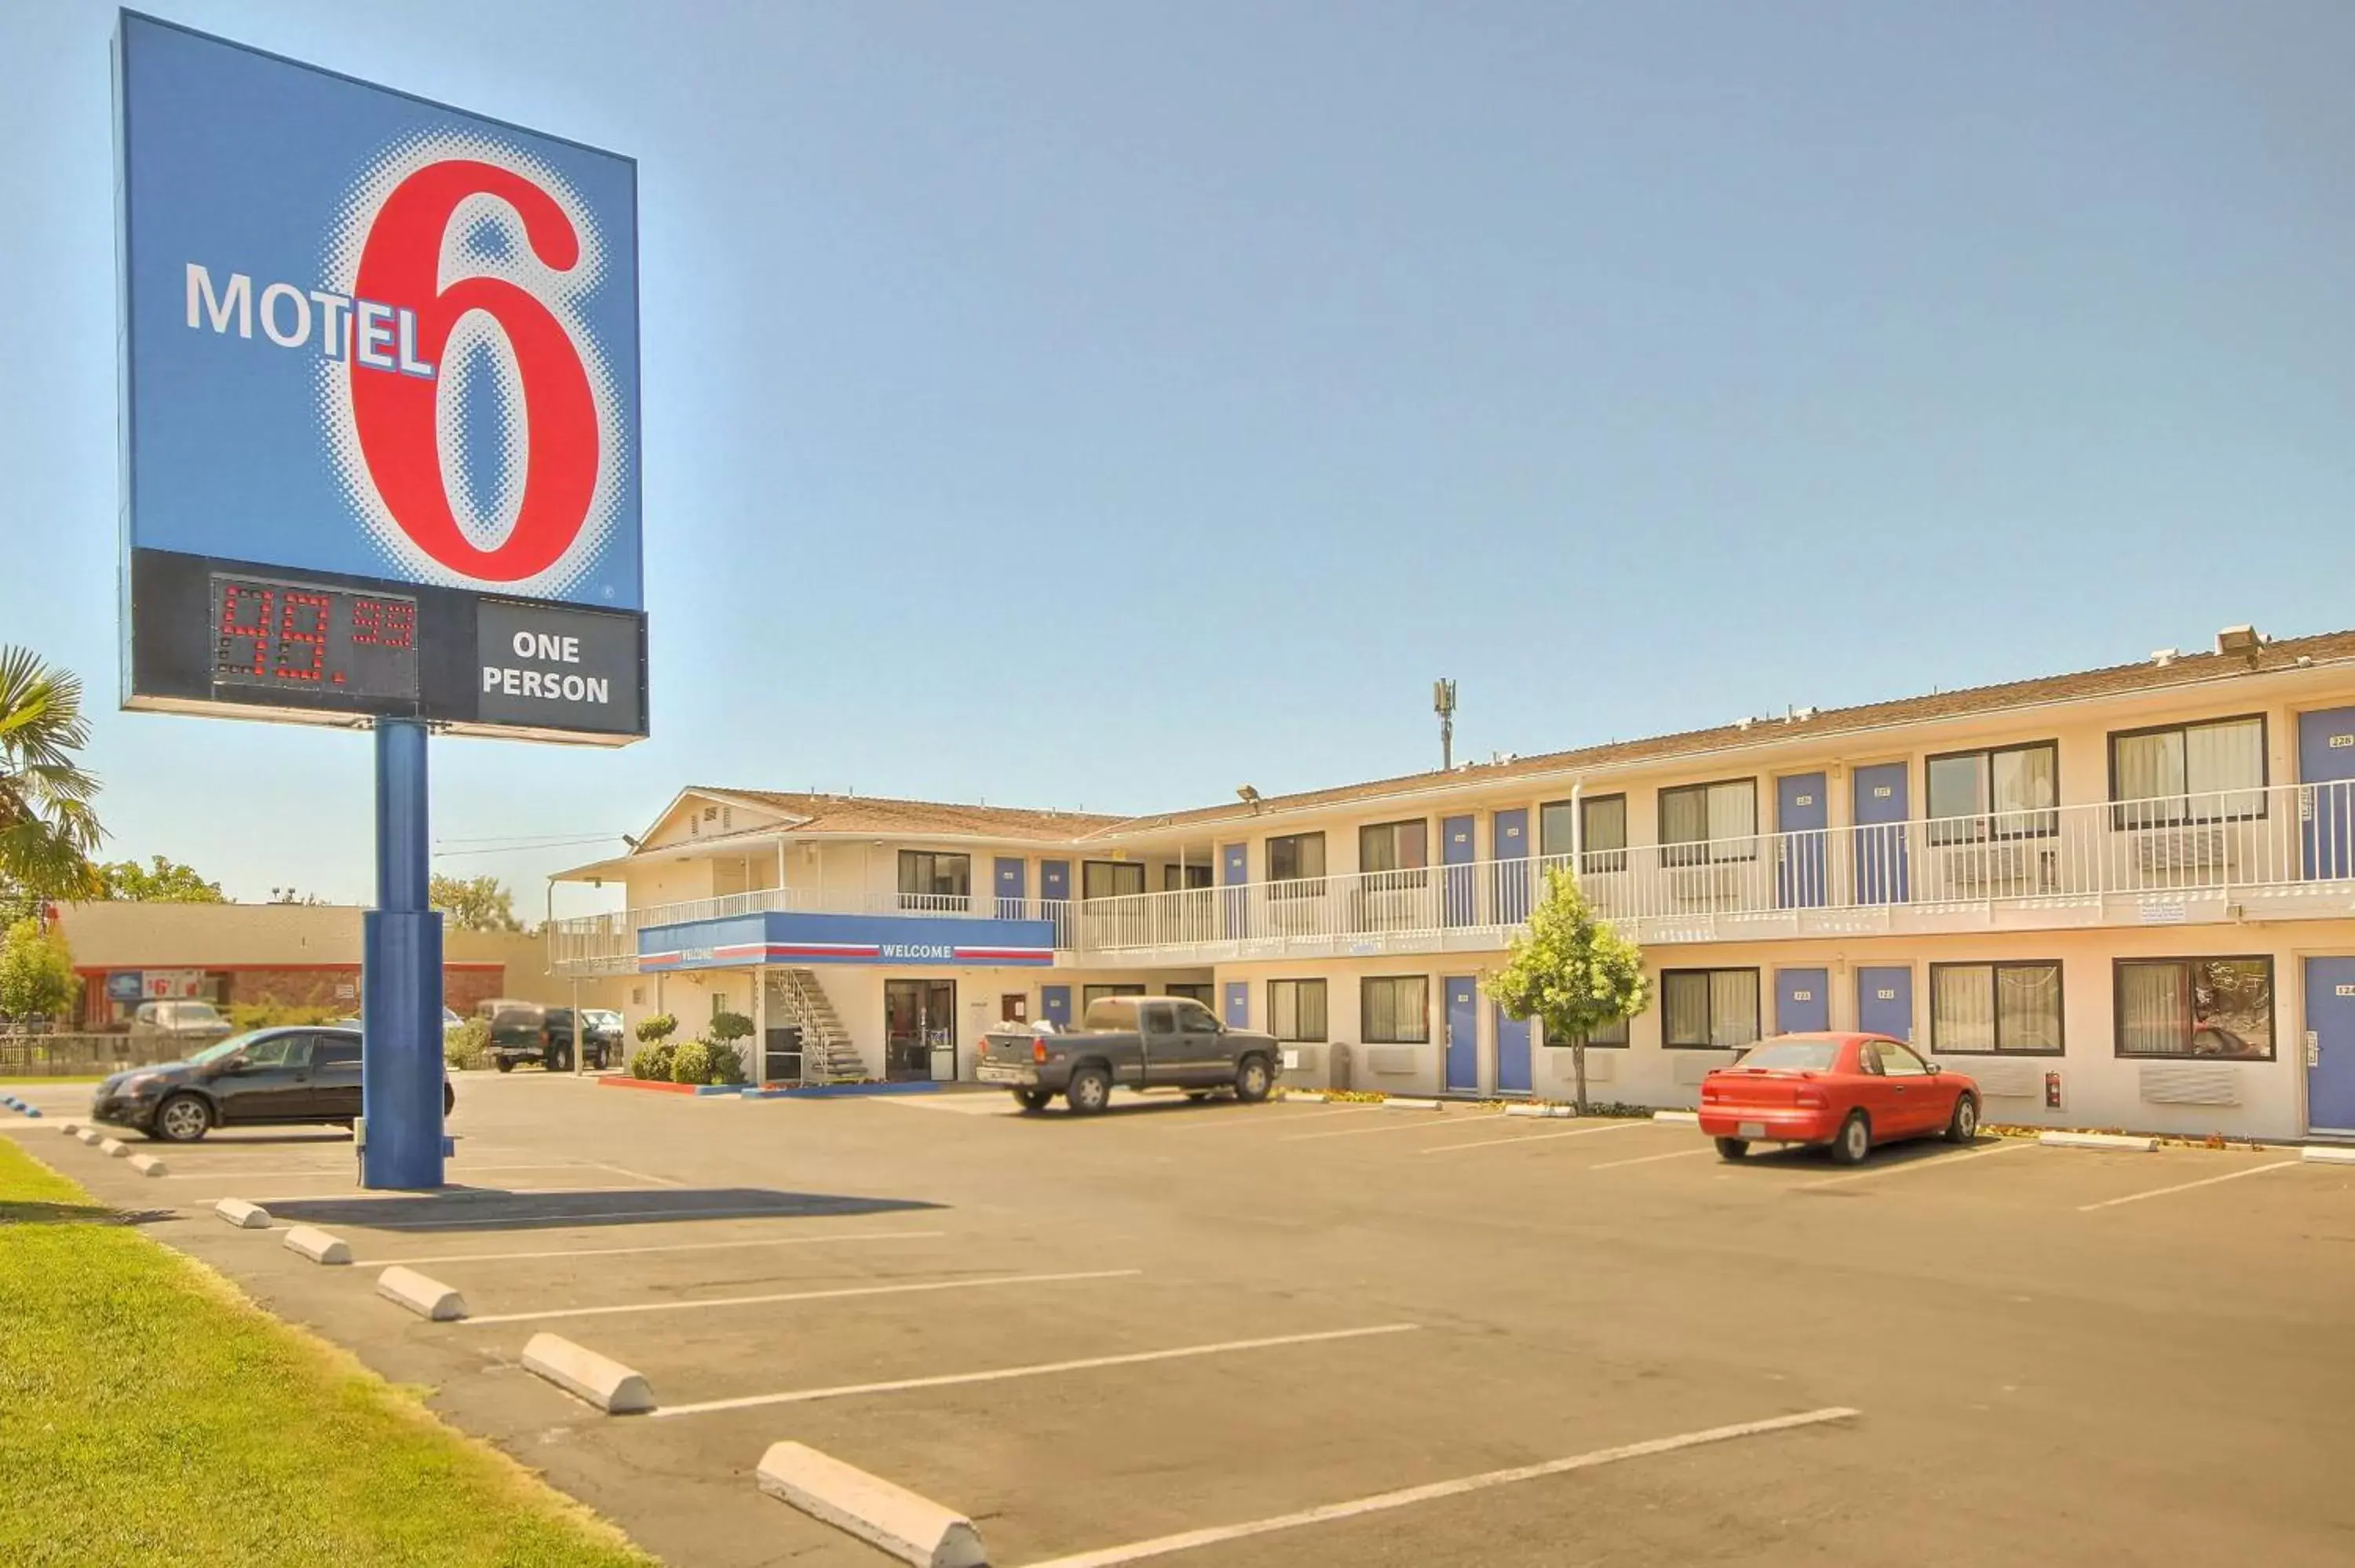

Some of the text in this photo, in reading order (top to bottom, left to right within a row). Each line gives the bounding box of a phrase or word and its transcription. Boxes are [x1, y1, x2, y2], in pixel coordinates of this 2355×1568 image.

[186, 159, 599, 582] MOTEL 6
[513, 631, 580, 663] ONE
[482, 665, 609, 704] PERSON
[882, 944, 951, 958] WELCOME
